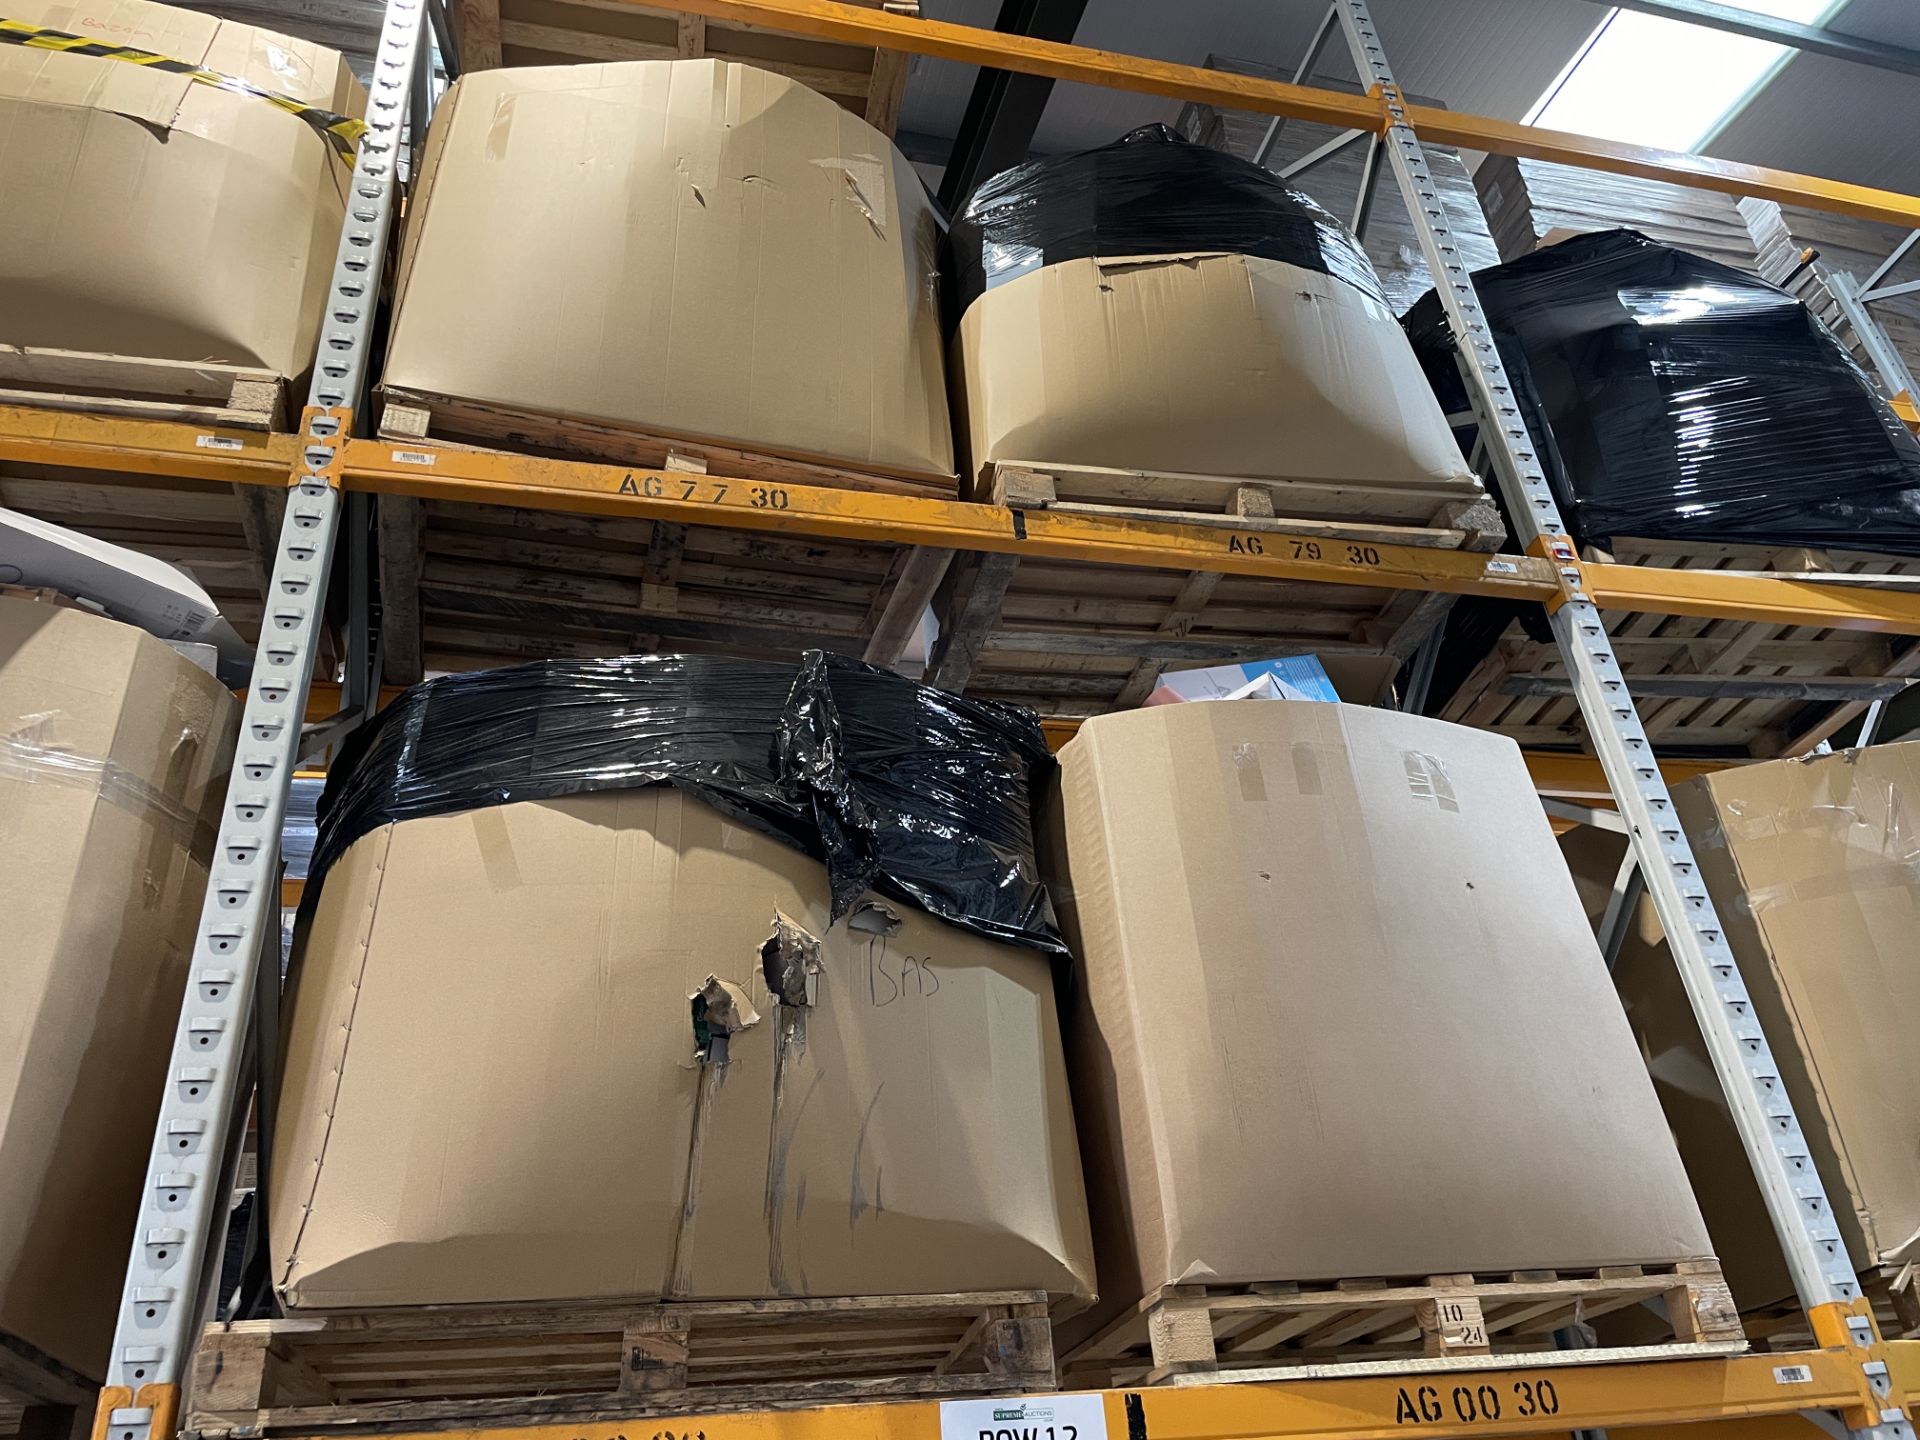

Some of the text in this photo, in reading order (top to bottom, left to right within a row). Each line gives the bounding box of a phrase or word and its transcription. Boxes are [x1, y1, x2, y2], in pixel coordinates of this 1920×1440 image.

[617, 474, 662, 497] AG
[750, 487, 789, 510] 30
[1228, 534, 1380, 565] AG 79 30
[1442, 1304, 1464, 1323] 10
[1396, 1379, 1559, 1424] AG 00 30
